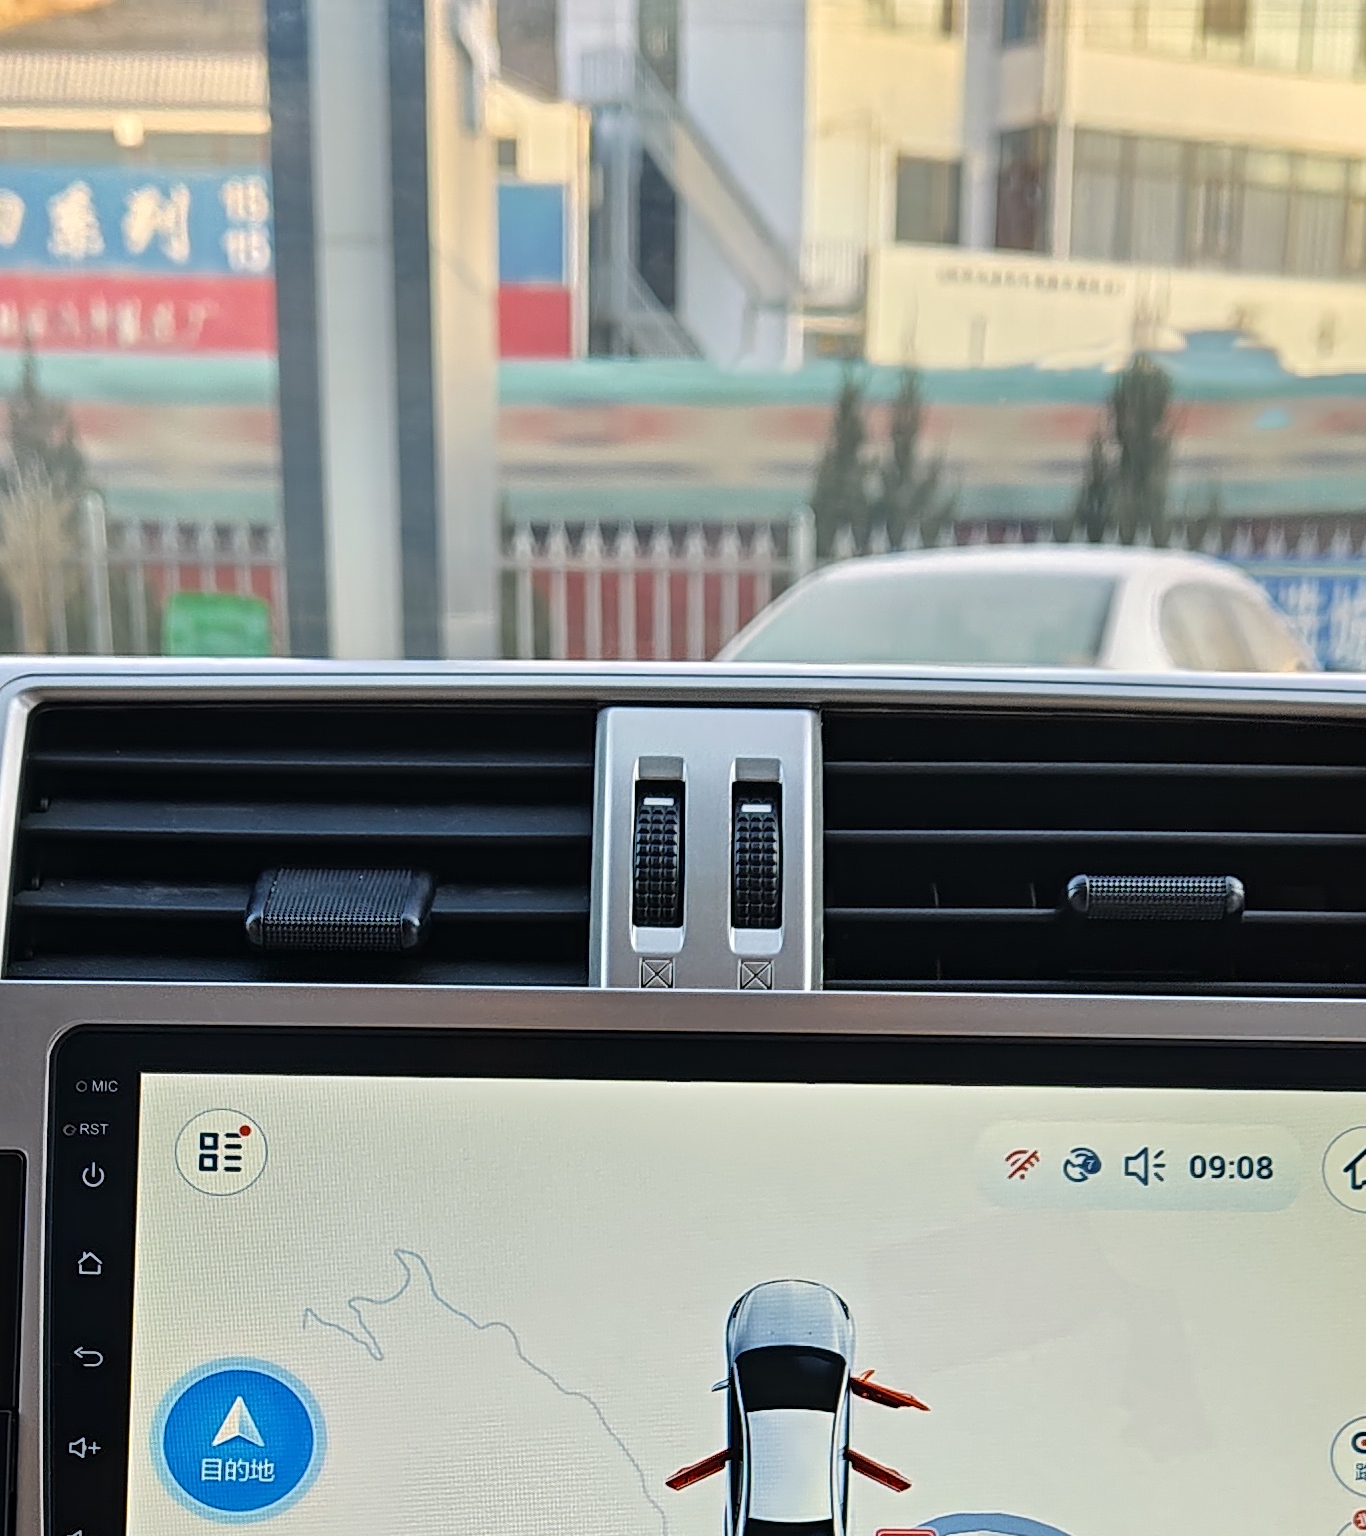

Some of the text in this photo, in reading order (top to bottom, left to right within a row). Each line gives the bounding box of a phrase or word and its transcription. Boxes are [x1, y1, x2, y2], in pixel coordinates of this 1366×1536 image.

[92, 1080, 118, 1093] MIC
[79, 1122, 109, 1136] RST
[1189, 1154, 1275, 1180] 09:08
[200, 1457, 276, 1483] 目的地
